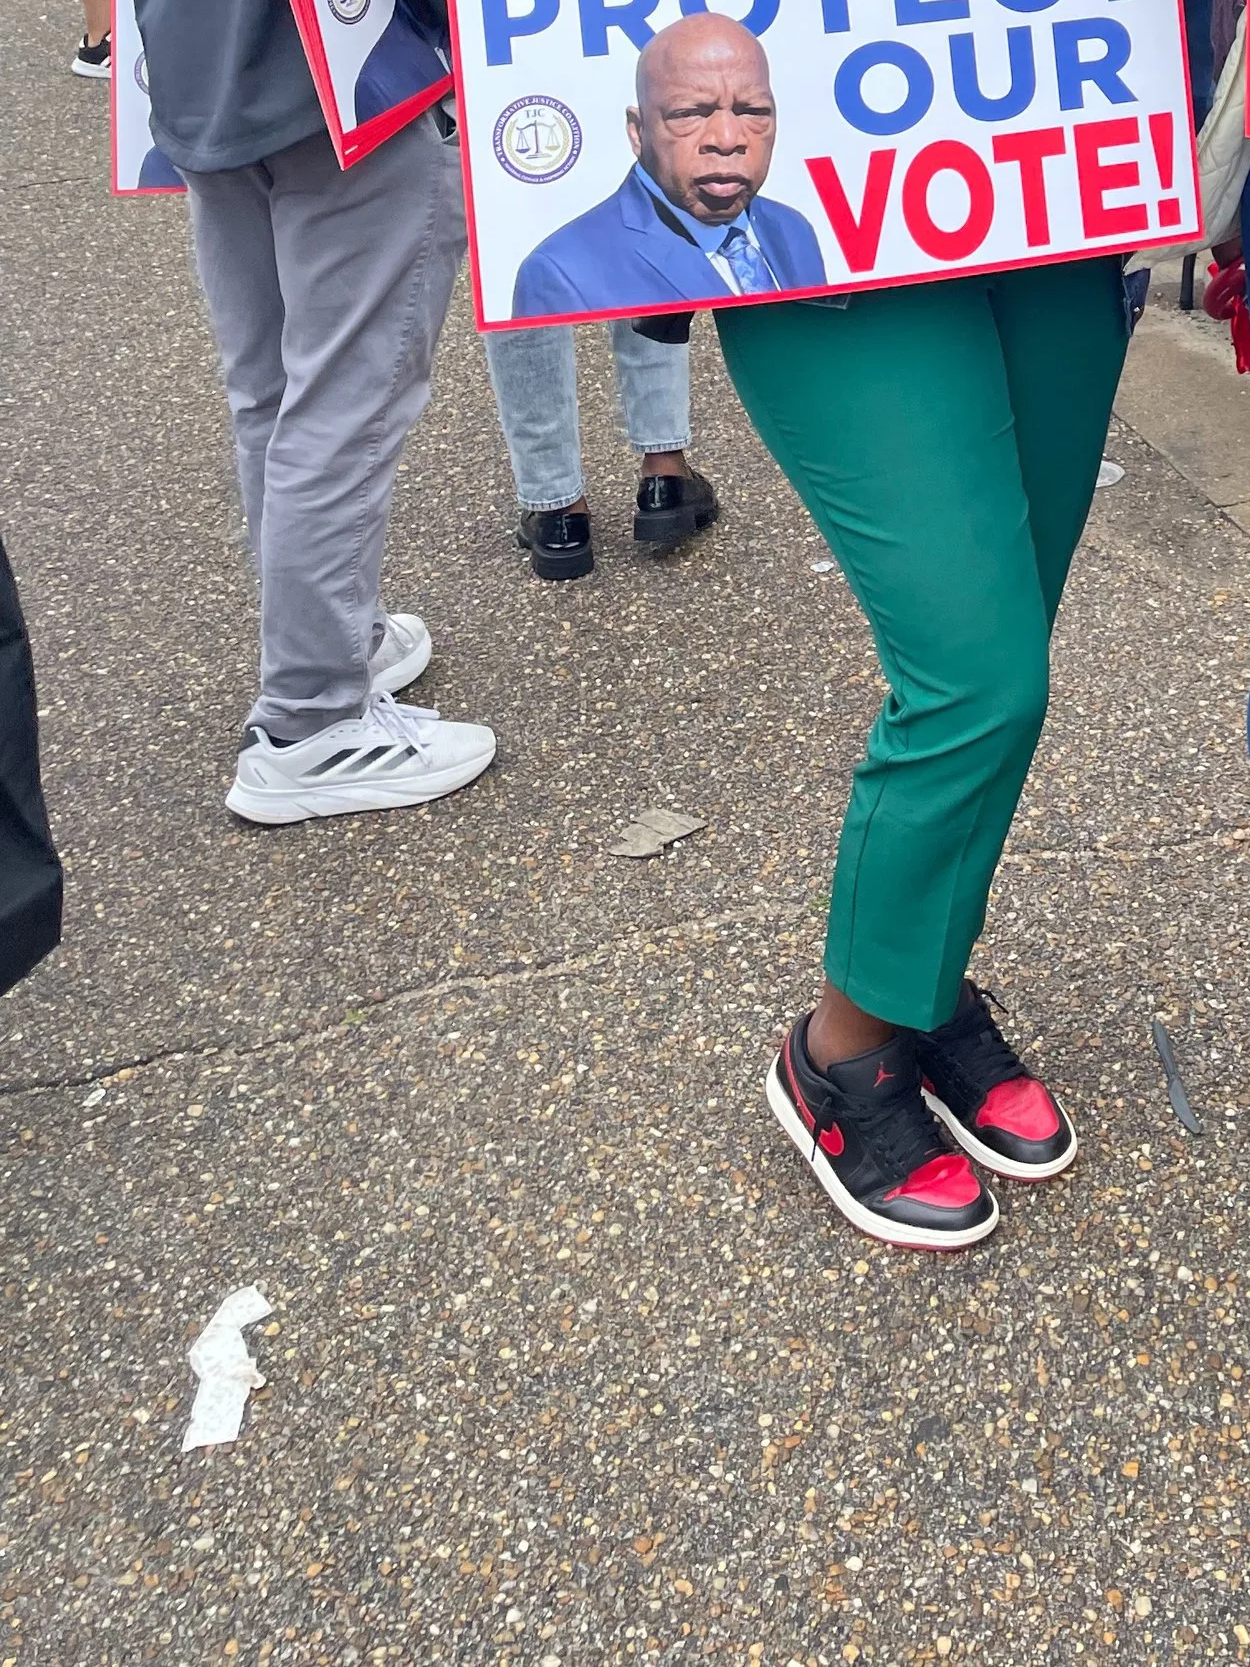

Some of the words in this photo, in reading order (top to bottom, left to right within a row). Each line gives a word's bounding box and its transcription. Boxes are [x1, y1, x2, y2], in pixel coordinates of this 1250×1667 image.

[524, 108, 546, 119] TJC
[834, 17, 1137, 136] OUR
[494, 97, 531, 157] TRANSFORMATIVE
[531, 97, 563, 110] JUSTICE
[561, 108, 581, 150] COALITION
[806, 111, 1182, 273] VOTE!
